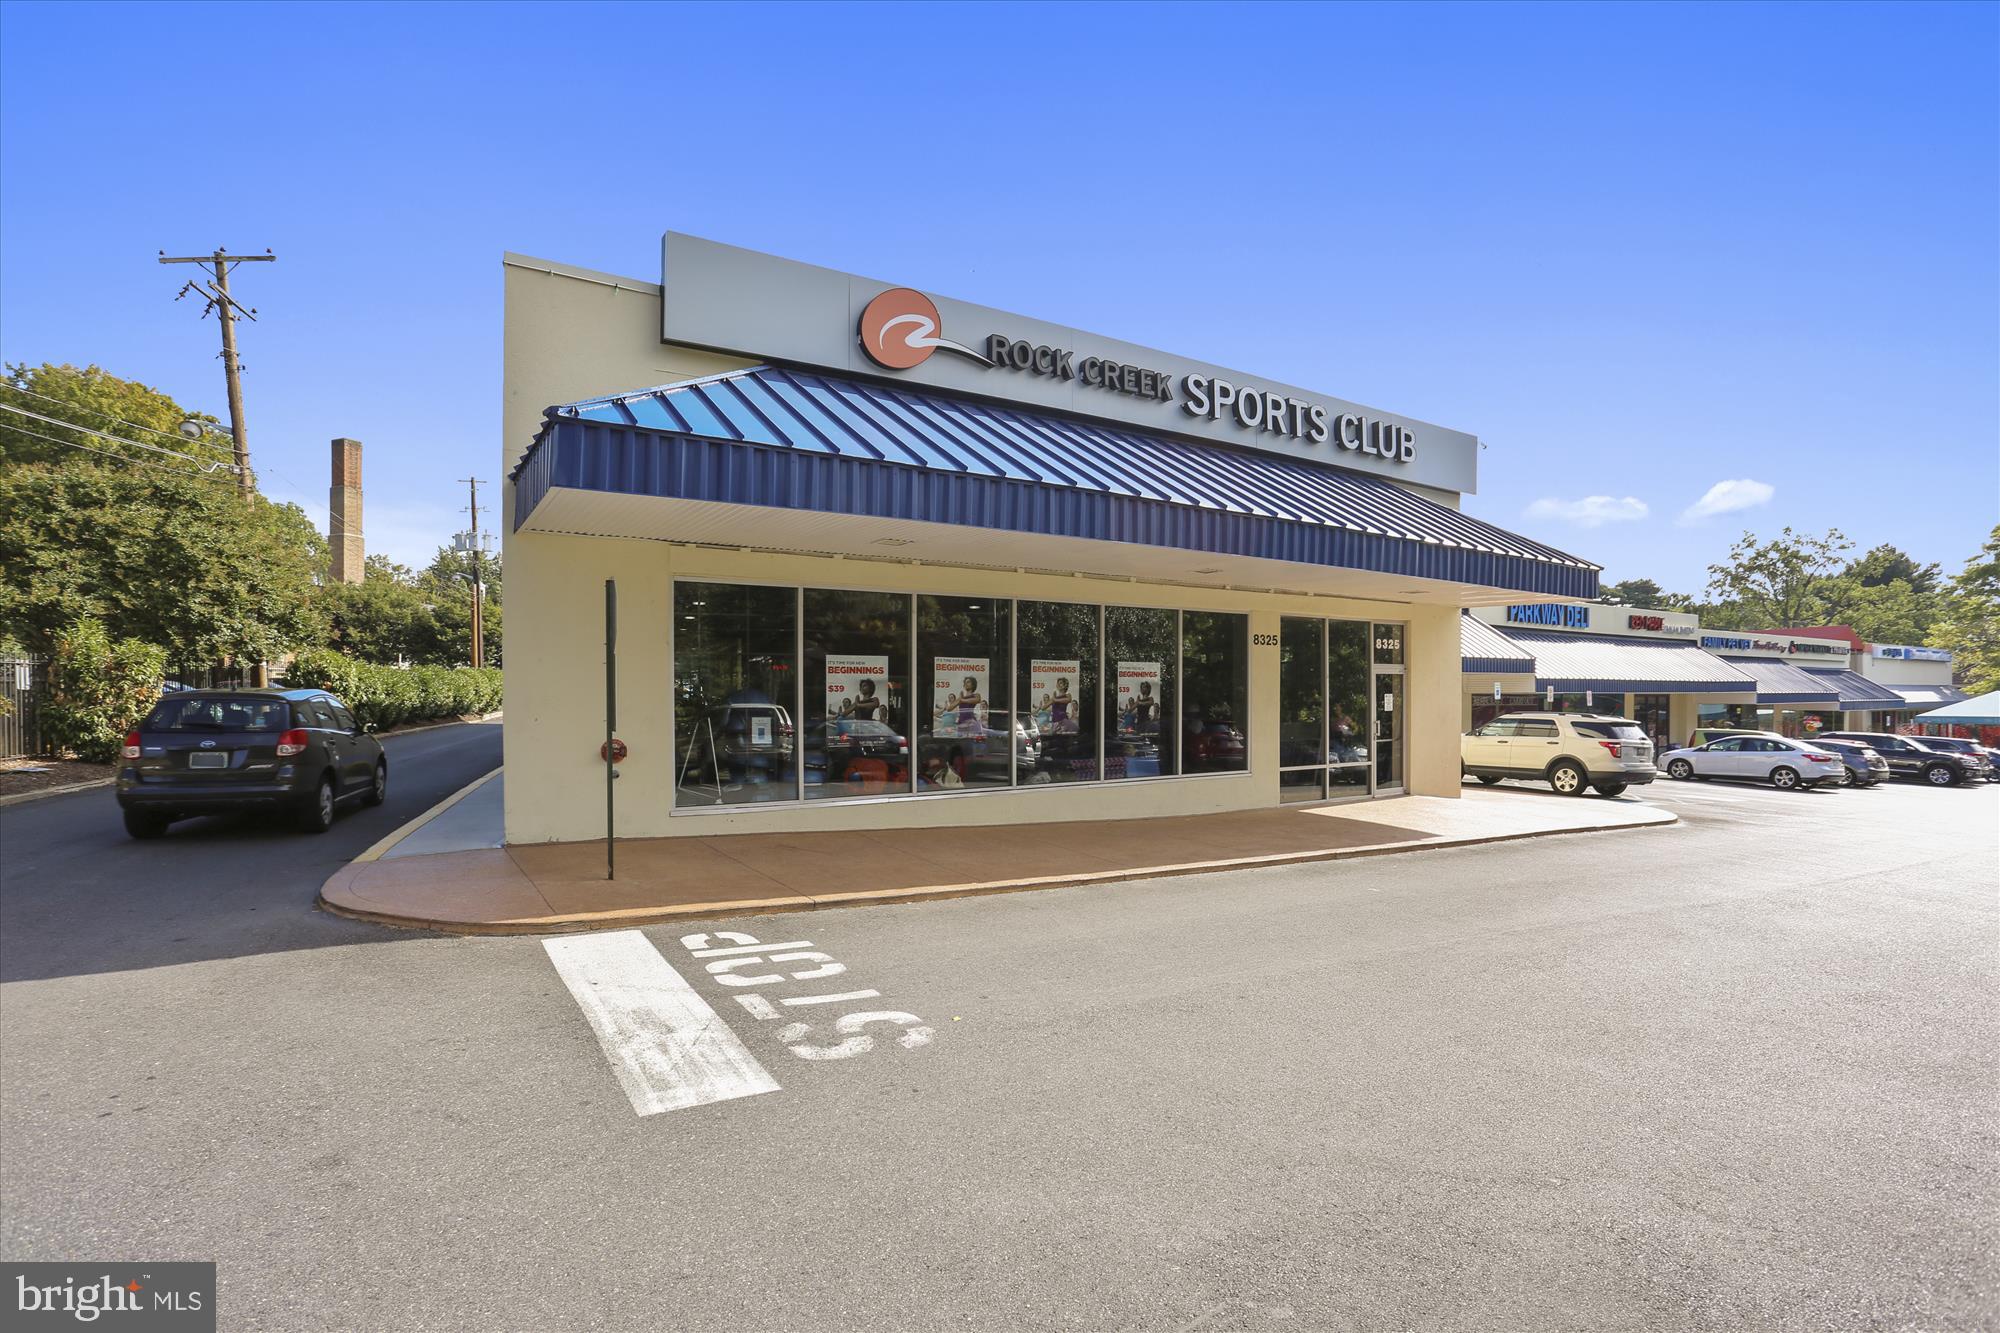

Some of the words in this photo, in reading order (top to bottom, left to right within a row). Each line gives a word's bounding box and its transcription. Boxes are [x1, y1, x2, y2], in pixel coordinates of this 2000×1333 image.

[987, 334, 1075, 381] ROCK
[1079, 356, 1174, 402] CREEK
[1182, 373, 1329, 444] SPORTS
[1334, 412, 1418, 463] CLUB
[1253, 633, 1278, 646] 8325
[1376, 638, 1400, 650] 8325
[828, 666, 884, 674] BEGINNINGS
[936, 663, 985, 672] BEGINNINGS
[1032, 666, 1077, 674] BEGINNINGS
[1119, 670, 1157, 678] BEGINNINGS
[828, 685, 845, 693] $39
[936, 681, 950, 689] $39
[680, 931, 937, 1062] STOP
